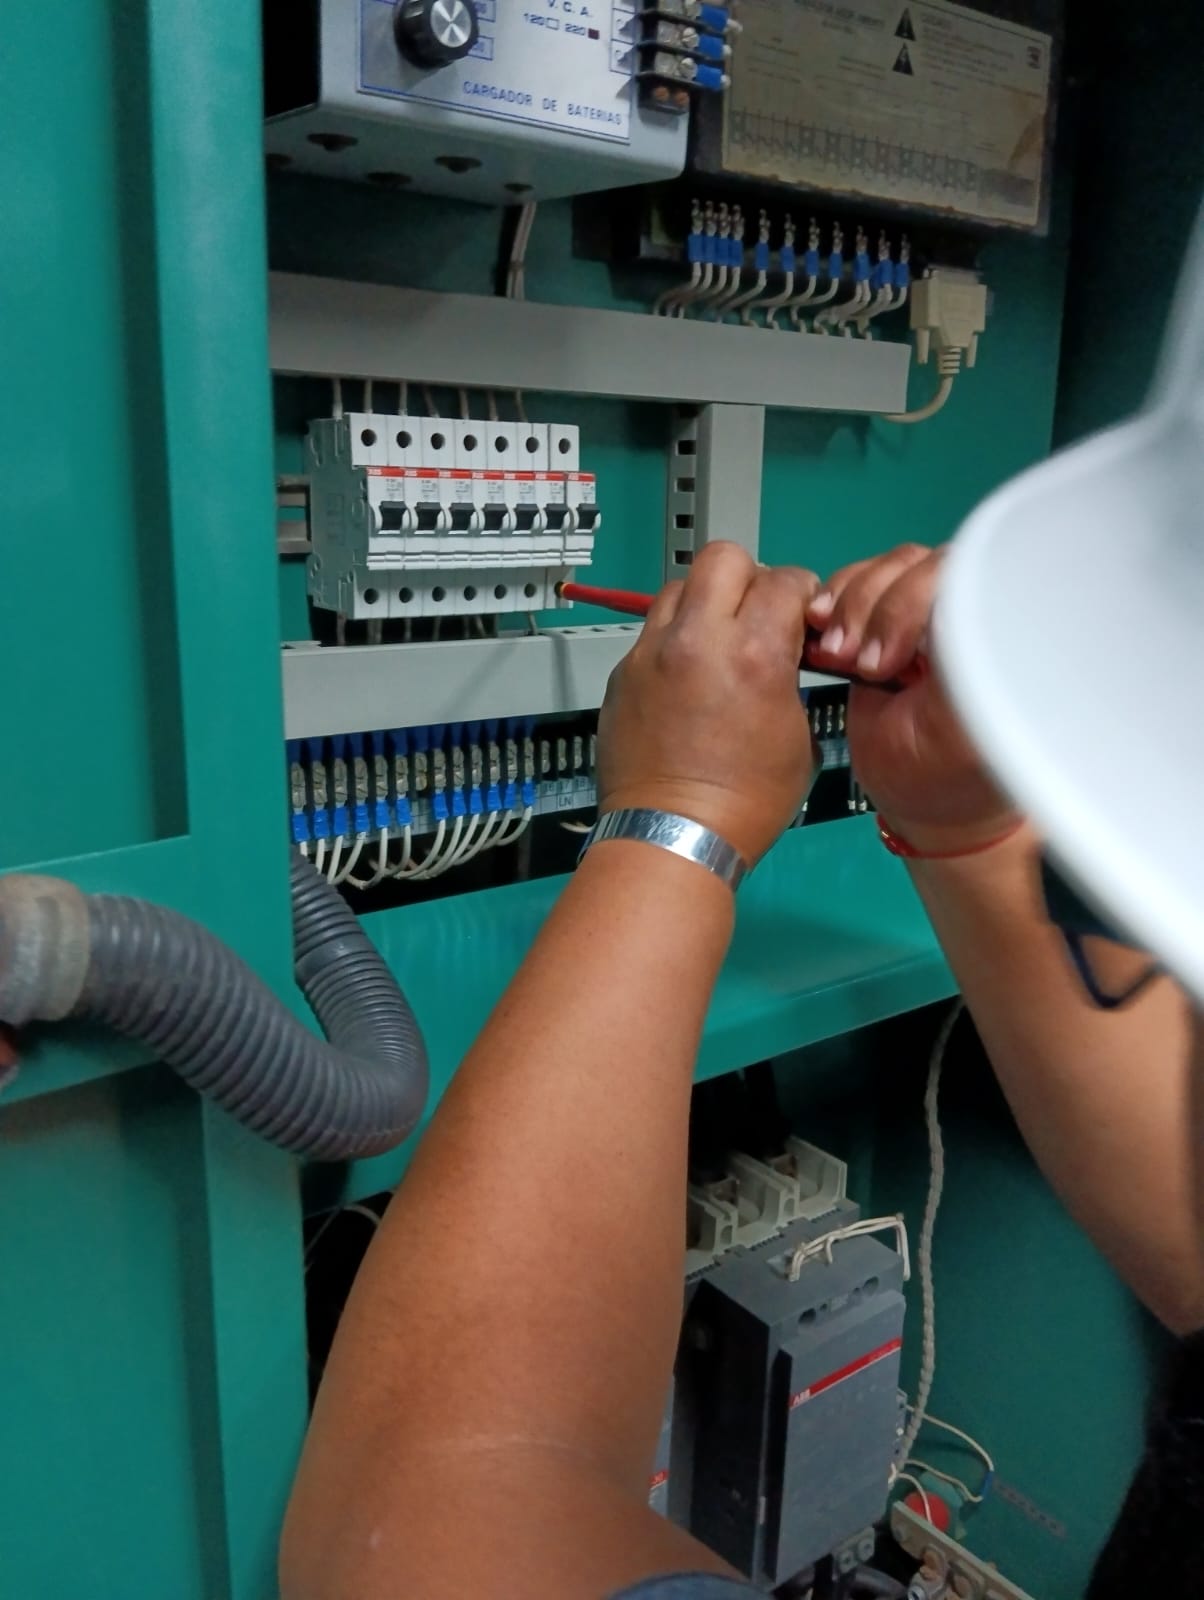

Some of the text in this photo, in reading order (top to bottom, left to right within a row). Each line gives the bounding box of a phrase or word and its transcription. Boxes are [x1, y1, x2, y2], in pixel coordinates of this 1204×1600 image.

[523, 13, 546, 26] 120
[564, 23, 587, 36] 220
[462, 81, 623, 126] CARGADOR DE BATERIAS
